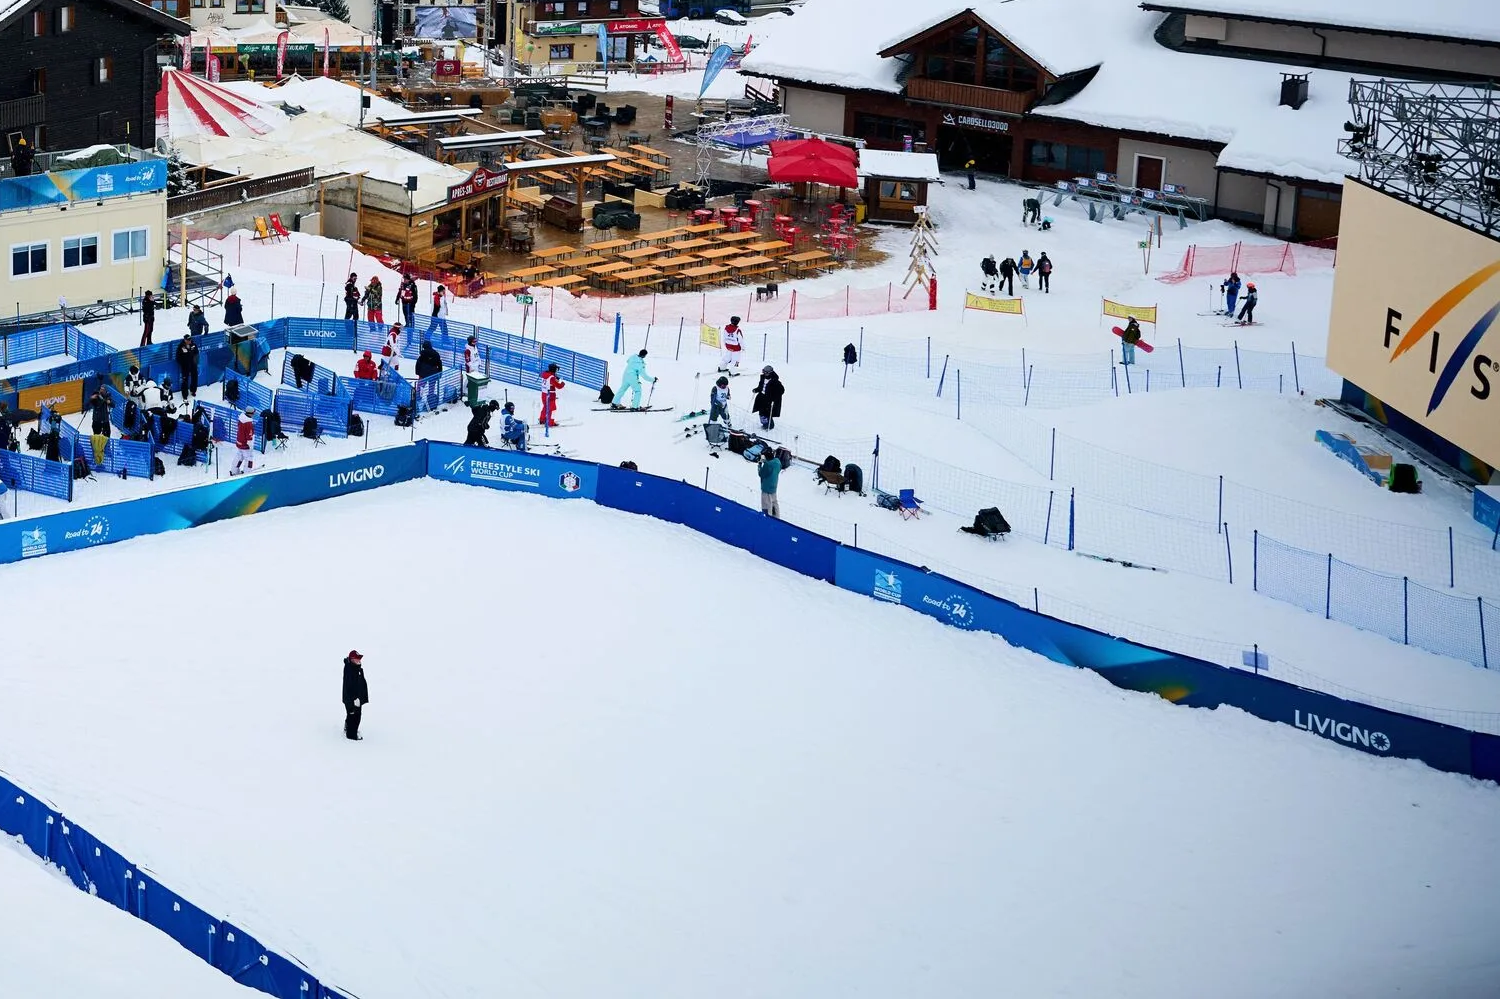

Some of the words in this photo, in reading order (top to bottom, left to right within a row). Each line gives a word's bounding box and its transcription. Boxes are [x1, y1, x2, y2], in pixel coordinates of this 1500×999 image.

[958, 115, 1009, 131] CAROSELLO3000
[451, 184, 473, 199] APRÈS-SKI
[486, 173, 508, 187] RESTAURANT
[303, 330, 337, 338] LIVIGNO
[66, 370, 95, 382] LIVIGNO
[35, 395, 66, 408] LIVIGNO
[470, 460, 523, 474] FREESTYLE
[524, 468, 540, 477] SKI
[471, 467, 498, 476] WORLD
[499, 471, 514, 479] CUP
[329, 464, 385, 488] LIVIGNO
[65, 530, 80, 539] Road
[22, 544, 38, 552] WORLD
[874, 586, 891, 596] WORLD
[922, 595, 941, 608] Road
[942, 602, 950, 611] to
[1294, 709, 1391, 751] LIVIGNO
